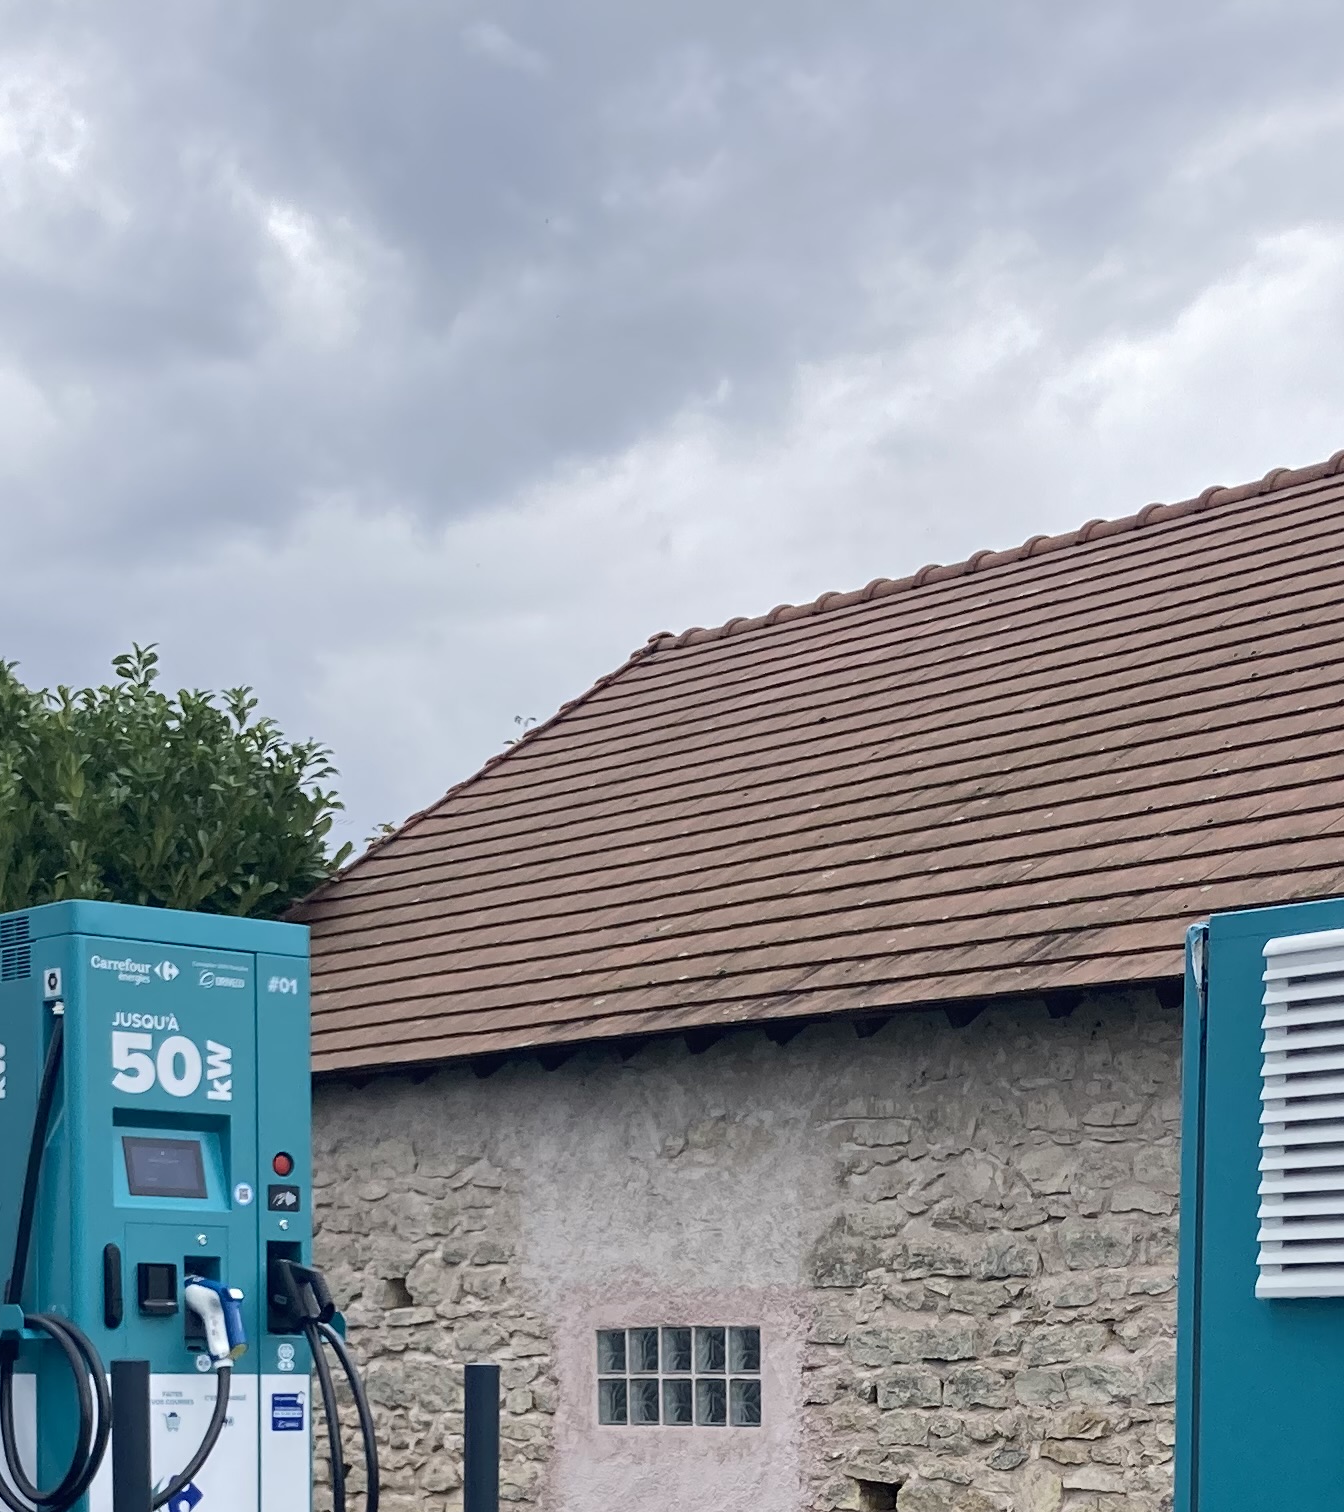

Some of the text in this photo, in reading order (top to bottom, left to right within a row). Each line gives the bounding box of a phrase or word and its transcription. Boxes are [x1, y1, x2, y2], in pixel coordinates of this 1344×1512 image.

[90, 955, 152, 974] Carrefour
[267, 976, 298, 995] #01
[112, 1011, 180, 1032] JUSQU'À
[111, 1031, 203, 1097] 50
